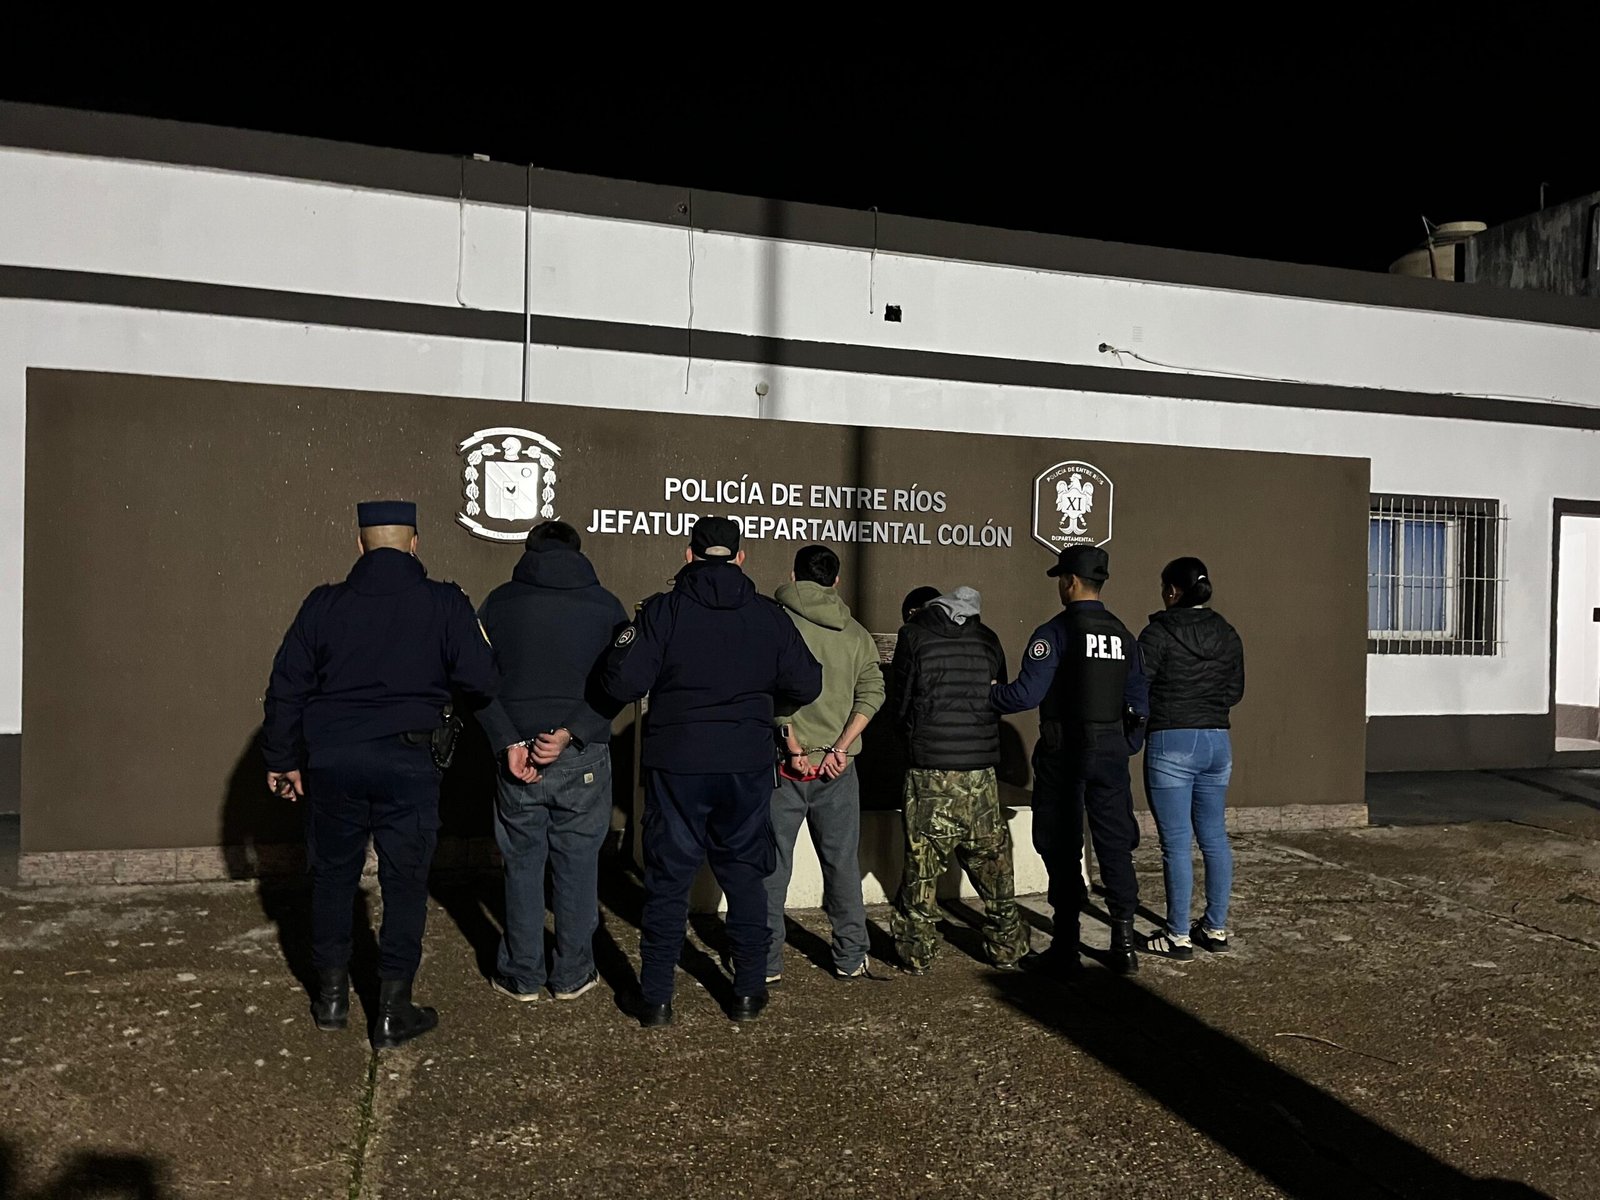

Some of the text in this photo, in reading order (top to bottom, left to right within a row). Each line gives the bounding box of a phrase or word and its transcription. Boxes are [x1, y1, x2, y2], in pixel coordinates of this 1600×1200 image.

[1075, 466, 1093, 477] ENTRE
[665, 473, 947, 513] POLICÍA DE ENTRE RÍOS
[1066, 497, 1082, 511] XI
[586, 508, 714, 536] JEFATUR
[937, 518, 1013, 547] COLÓN
[1051, 535, 1095, 543] DEPARTAMENTAL
[1085, 633, 1126, 660] P.E.R.
